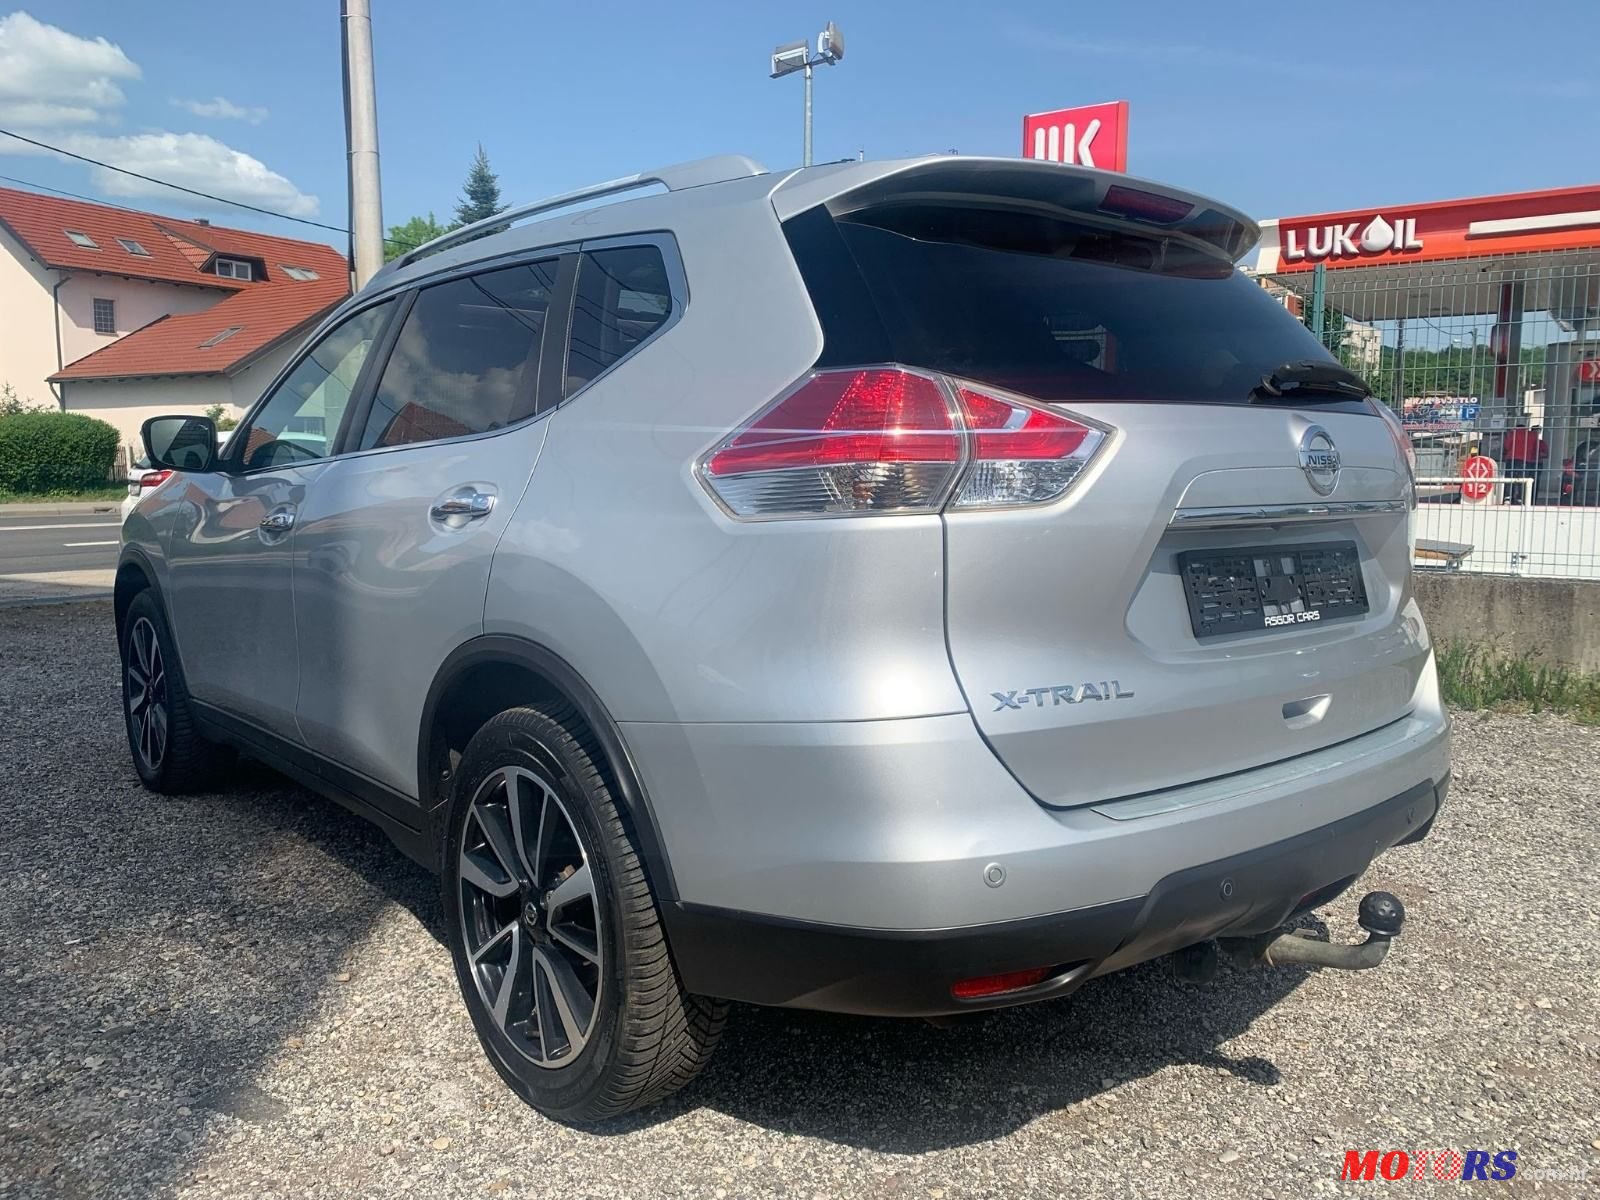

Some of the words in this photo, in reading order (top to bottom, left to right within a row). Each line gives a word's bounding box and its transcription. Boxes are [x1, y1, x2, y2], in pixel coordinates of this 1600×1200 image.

[1287, 214, 1424, 259] LUKOIL
[1264, 613, 1296, 627] ASGOR
[1297, 610, 1320, 623] CARS
[990, 680, 1135, 712] X-TRAIL
